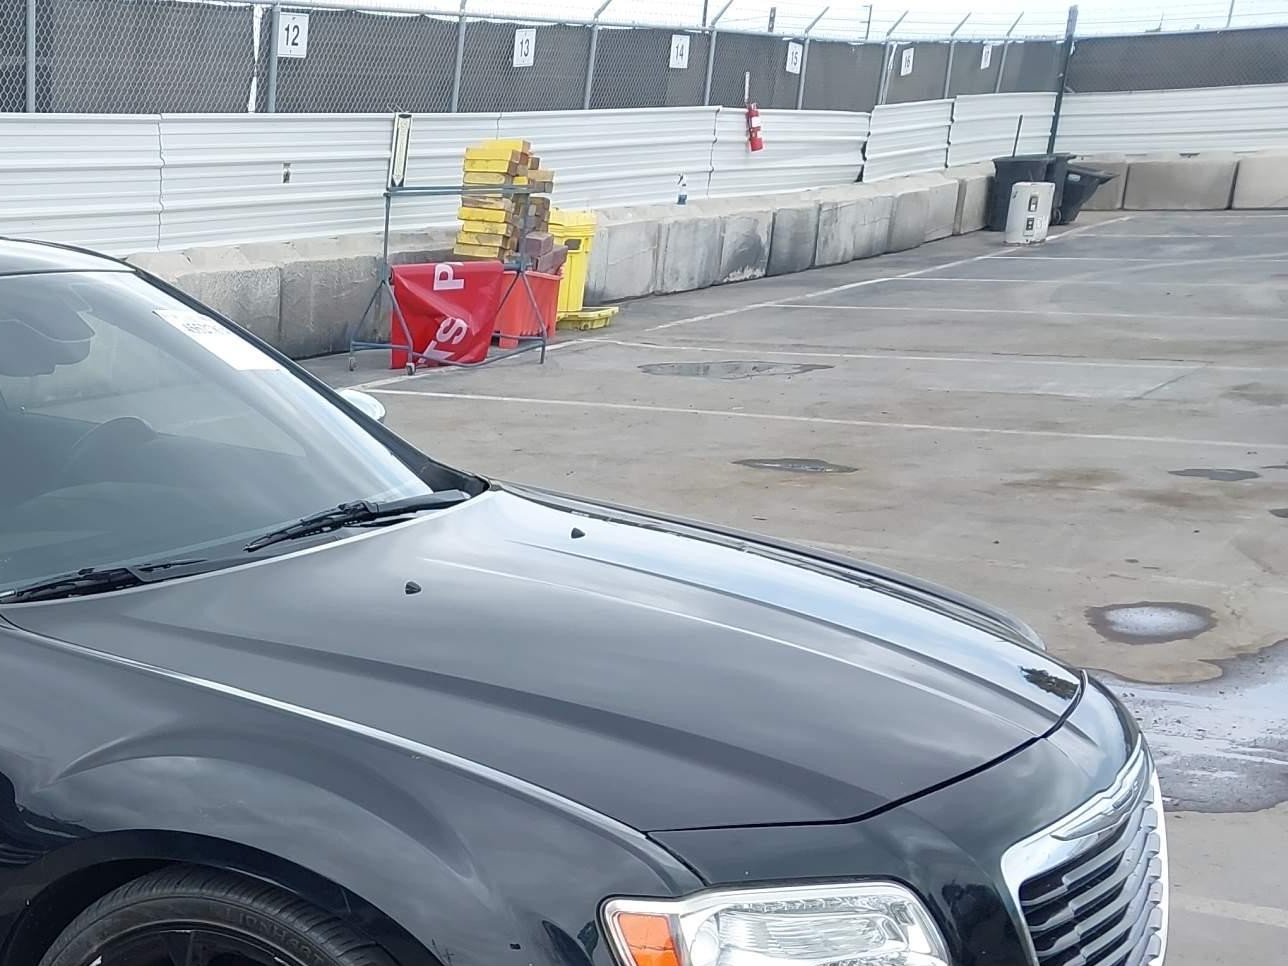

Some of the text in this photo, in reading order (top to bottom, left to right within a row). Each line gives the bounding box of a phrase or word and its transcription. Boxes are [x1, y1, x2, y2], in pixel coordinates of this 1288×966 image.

[284, 23, 300, 46] 12
[520, 38, 530, 58] 13
[675, 44, 685, 61] 14
[790, 51, 799, 67] 15
